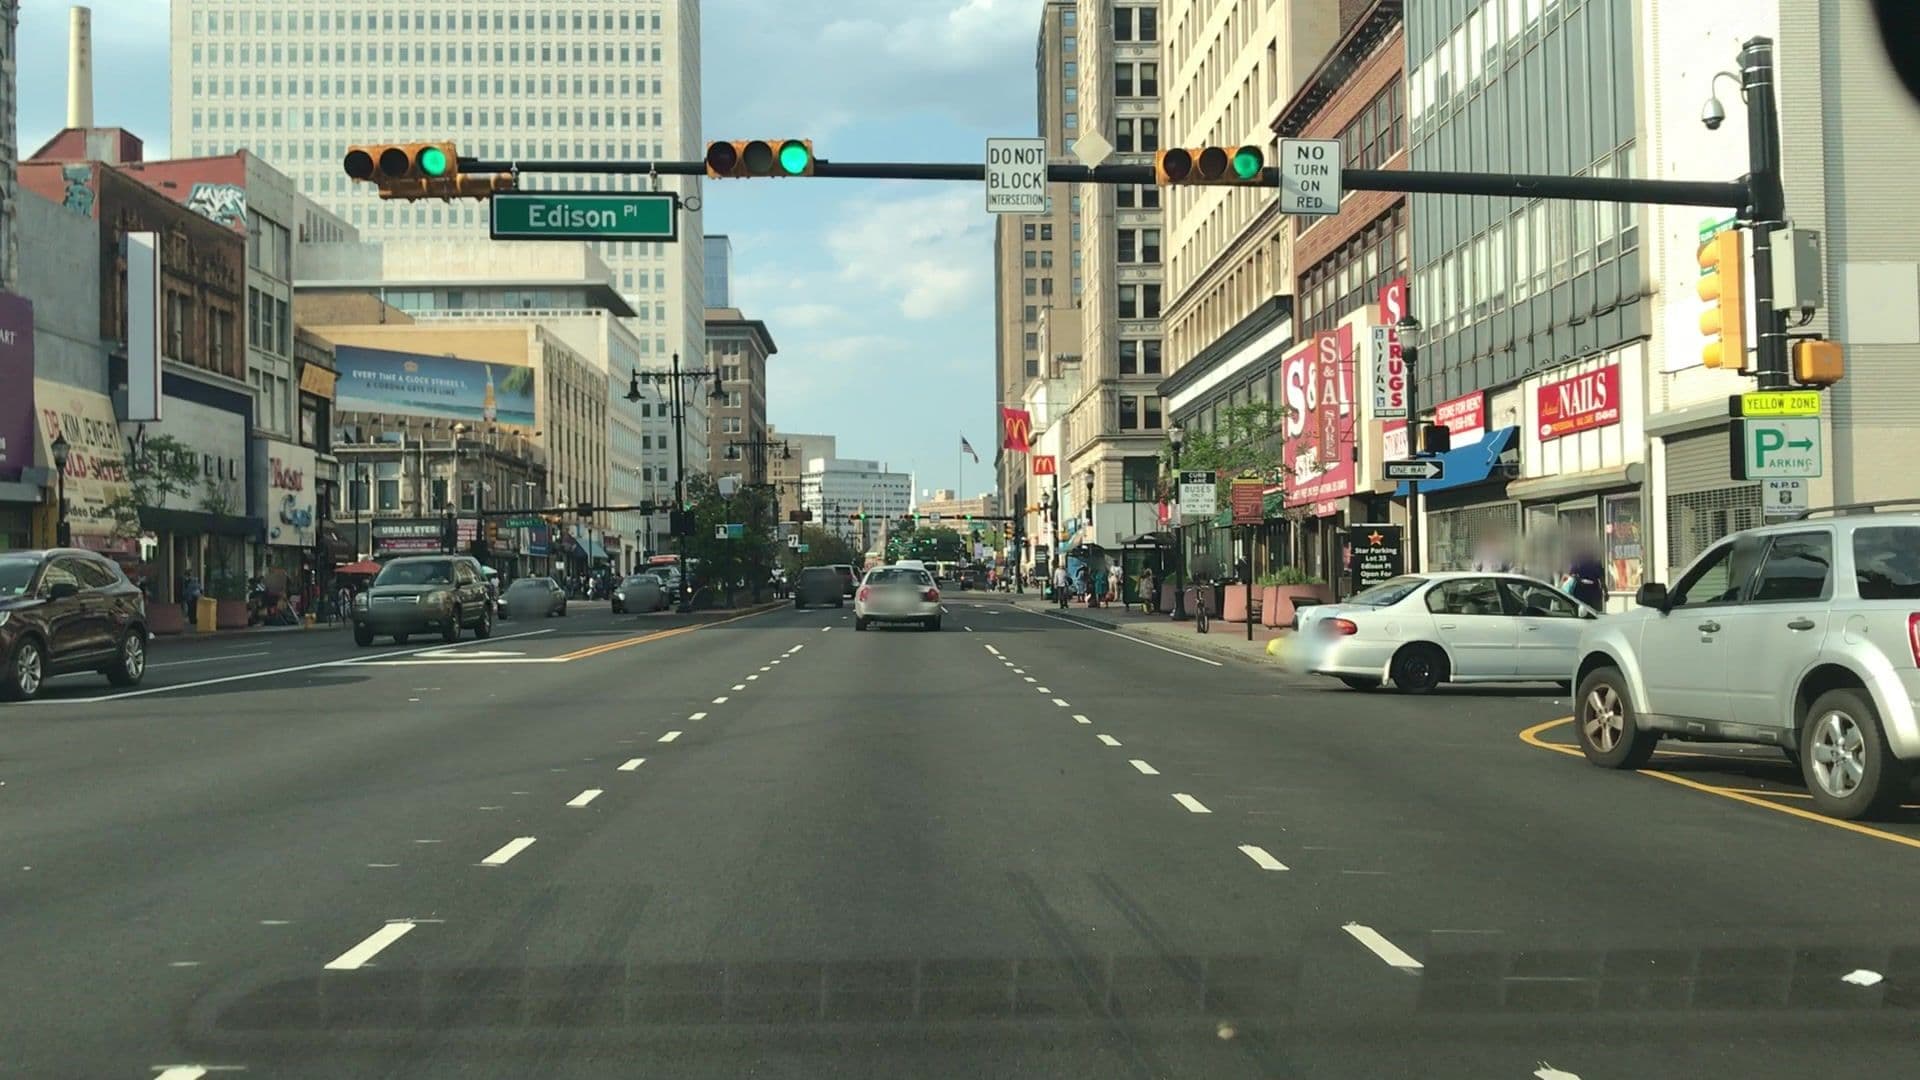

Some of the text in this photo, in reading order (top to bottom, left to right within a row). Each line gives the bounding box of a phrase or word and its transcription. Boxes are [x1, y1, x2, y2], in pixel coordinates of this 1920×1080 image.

[990, 148, 1043, 166] DO NOT
[1297, 146, 1324, 161] NO
[1293, 164, 1329, 177] TURN
[990, 171, 1043, 190] BLOCK
[1300, 180, 1320, 192] ON
[988, 194, 1043, 207] INTERSECTION
[1297, 196, 1323, 209] RED
[528, 204, 638, 228] Edison Pl
[353, 369, 377, 380] EVERY
[379, 372, 396, 382] TIME
[405, 375, 430, 385] CLOCK
[1559, 372, 1607, 419] NAILS
[1747, 396, 1817, 411] YELLOW ZONE
[1391, 466, 1427, 474] ONE WAY
[1184, 486, 1212, 494] BUSES
[382, 526, 413, 534] URBAN
[1370, 547, 1397, 555] Parking
